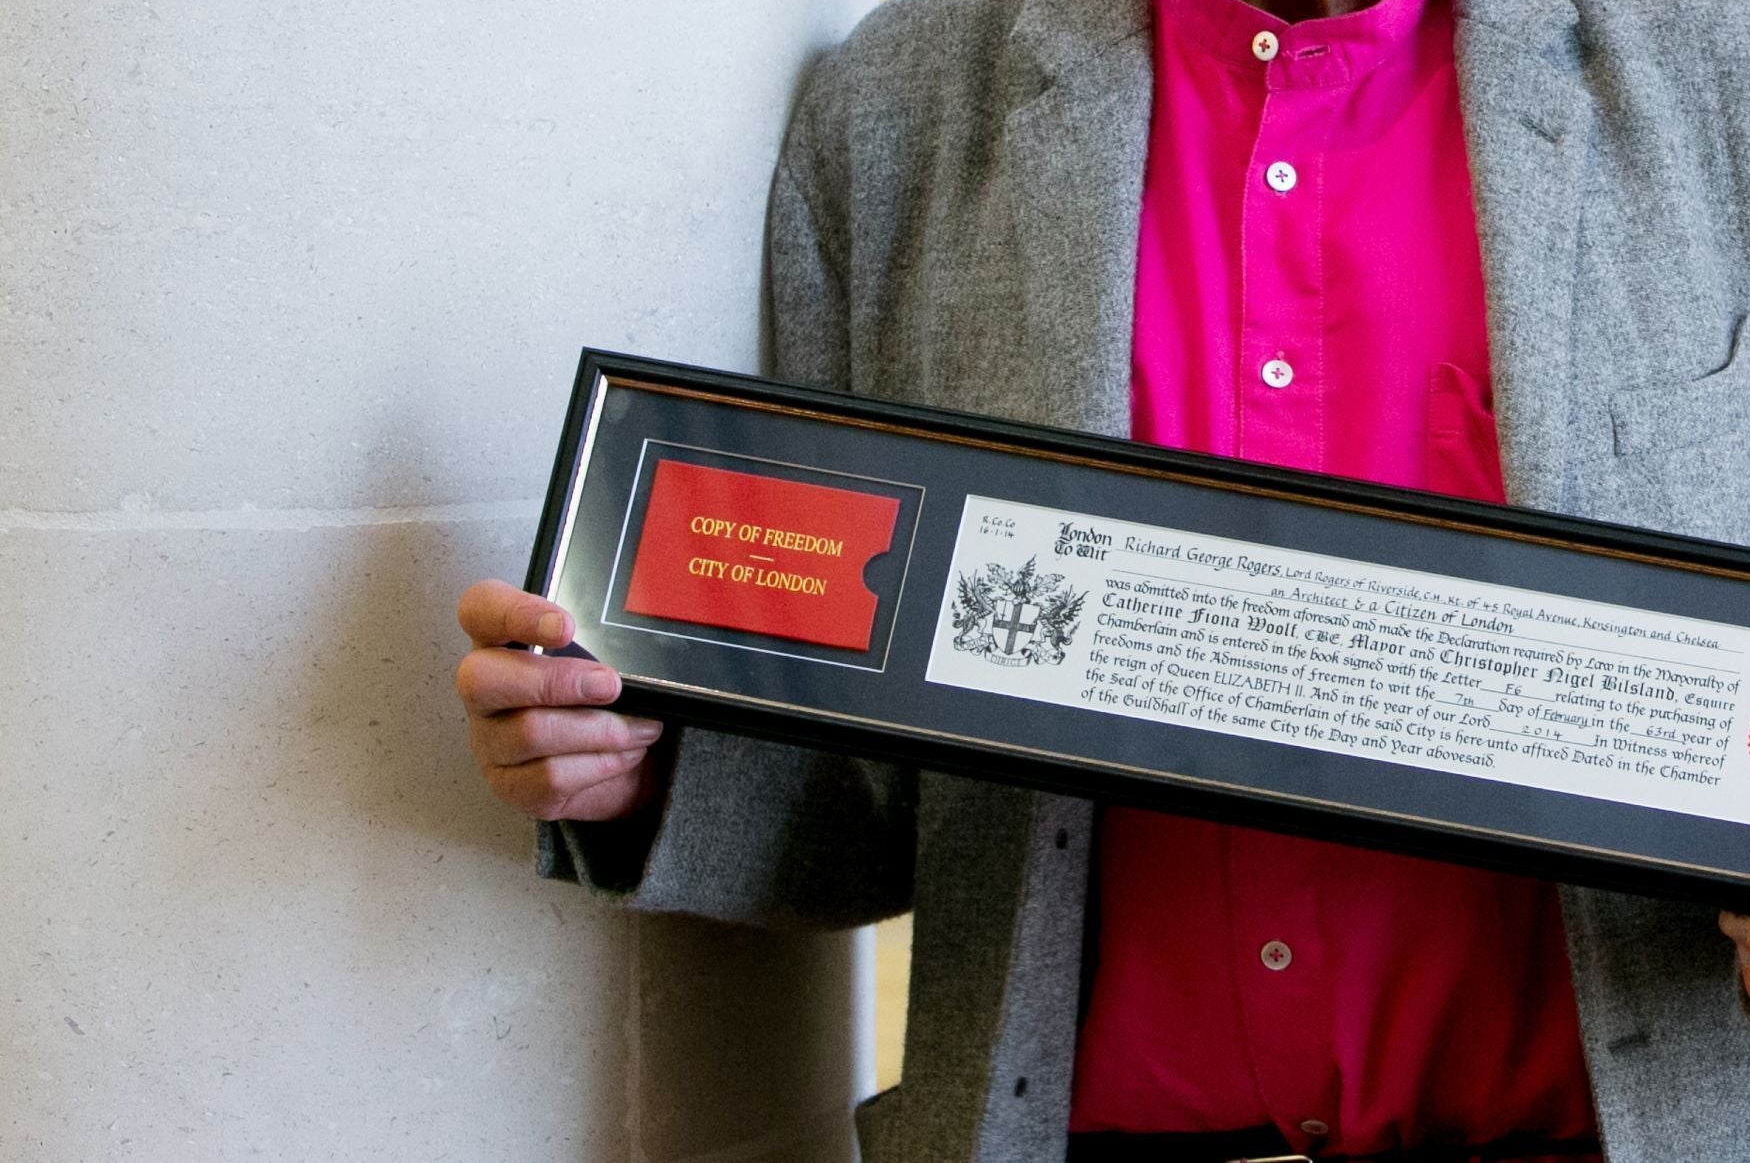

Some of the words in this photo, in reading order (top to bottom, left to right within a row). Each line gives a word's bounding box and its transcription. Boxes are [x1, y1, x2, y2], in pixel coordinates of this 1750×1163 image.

[688, 557, 730, 577] CITY
[731, 564, 753, 583] OF
[755, 570, 828, 596] LONDON
[691, 516, 737, 538] COPY
[738, 524, 762, 543] OF
[763, 529, 844, 557] FREEDOM
[1054, 539, 1073, 556] To
[1076, 544, 1112, 561] Wit
[1058, 522, 1112, 546] London
[1105, 578, 1131, 591] was
[1133, 580, 1190, 601] admitted
[1192, 593, 1218, 606] into
[1220, 594, 1239, 610] the
[1242, 597, 1291, 618] freedom
[1293, 607, 1351, 628] aforesaid
[1351, 618, 1377, 632] and
[1378, 623, 1412, 639] made
[1415, 627, 1435, 643] the
[1436, 630, 1510, 655] Declaration
[1513, 647, 1565, 664] required
[1565, 652, 1583, 671] by
[1584, 657, 1615, 672] Law
[1617, 660, 1630, 675] in
[1633, 663, 1652, 679] the
[1654, 667, 1725, 694] Mayoralty
[1726, 679, 1741, 695] of
[1124, 536, 1182, 559] Richard
[1186, 547, 1233, 572] George
[1285, 567, 1312, 580] Lord
[1314, 571, 1350, 589] Rogers
[1352, 577, 1367, 589] of
[1466, 597, 1481, 609] of
[1483, 602, 1499, 613] 45
[1502, 603, 1533, 620] Royal
[1582, 617, 1647, 638] Kensington
[1649, 630, 1672, 642] and
[1676, 631, 1719, 650] Chelsea
[1270, 588, 1285, 598] an
[1291, 587, 1348, 608] Architect
[1354, 598, 1365, 610] &
[1368, 601, 1378, 612] a
[1384, 600, 1436, 621] Citizen
[1441, 609, 1459, 624] of
[1461, 613, 1513, 634] London
[1089, 648, 1110, 664] the
[1113, 653, 1147, 672] reign
[1150, 659, 1166, 676] of
[1167, 663, 1210, 682] Queen
[1213, 670, 1291, 695] ELIZABETH
[1309, 686, 1339, 703] And
[1342, 690, 1355, 706] in
[1359, 694, 1380, 711] the
[1383, 701, 1414, 715] year
[1416, 704, 1432, 721] of
[1432, 710, 1457, 723] our
[1458, 712, 1492, 729] Lord
[1591, 734, 1608, 748] In
[1613, 737, 1668, 758] Witness
[1671, 748, 1727, 769] whereof
[1093, 629, 1153, 652] freedoms
[1156, 643, 1183, 658] and
[1186, 646, 1206, 663] the
[1209, 650, 1288, 675] Admissions
[1291, 664, 1307, 680] of
[1307, 667, 1365, 688] Freemen
[1370, 677, 1384, 691] to
[1387, 683, 1411, 696] wit
[1415, 684, 1436, 701] the
[1498, 698, 1524, 718] day
[1527, 704, 1543, 719] of
[1541, 708, 1589, 730] February
[1591, 713, 1605, 728] in
[1609, 717, 1630, 733] the
[1645, 725, 1676, 740] 63rd
[1679, 733, 1713, 746] year
[1715, 735, 1731, 751] of
[1097, 612, 1178, 638] Chamberlain
[1180, 627, 1206, 642] and
[1208, 630, 1219, 645] is
[1222, 636, 1270, 653] entered
[1271, 640, 1284, 655] in
[1287, 644, 1307, 660] the
[1309, 646, 1340, 664] book
[1342, 656, 1385, 672] signed
[1386, 663, 1417, 679] with
[1419, 666, 1439, 682] the
[1440, 671, 1483, 689] Letter
[1555, 690, 1606, 712] relating
[1609, 699, 1623, 712] to
[1626, 701, 1646, 717] the
[1719, 716, 1734, 733] of
[1102, 592, 1183, 619] Catherine
[1187, 607, 1240, 629] Fiona
[1347, 633, 1406, 656] Mayor
[1409, 646, 1436, 661] and
[1439, 648, 1539, 679] Christopher
[1543, 666, 1595, 689] Nigel
[1601, 674, 1678, 703] Bilsland,
[1684, 692, 1736, 711] Esquire
[1080, 686, 1097, 703] of
[1098, 688, 1119, 705] the
[1122, 694, 1190, 716] Guildhall
[1189, 704, 1206, 721] of
[1207, 707, 1228, 724] the
[1231, 715, 1266, 730] same
[1270, 719, 1300, 738] City
[1304, 723, 1325, 740] the
[1327, 727, 1358, 748] Day
[1361, 735, 1388, 750] and
[1390, 739, 1423, 755] Year
[1426, 744, 1495, 768] abovesaid.
[1085, 667, 1106, 684] the
[1108, 672, 1141, 688] Seal
[1141, 677, 1157, 693] of
[1159, 680, 1179, 696] the
[1182, 684, 1224, 703] Office
[1227, 692, 1243, 708] of
[1244, 695, 1330, 721] Chamberlain
[1333, 709, 1349, 726] of
[1351, 712, 1371, 728] the
[1374, 718, 1404, 733] said
[1406, 722, 1436, 742] City
[1440, 727, 1452, 741] is
[1521, 741, 1569, 761] affixed
[1571, 749, 1614, 768] Dated
[1618, 756, 1631, 771] in
[1635, 760, 1656, 775] the
[1659, 765, 1721, 786] Chamber
